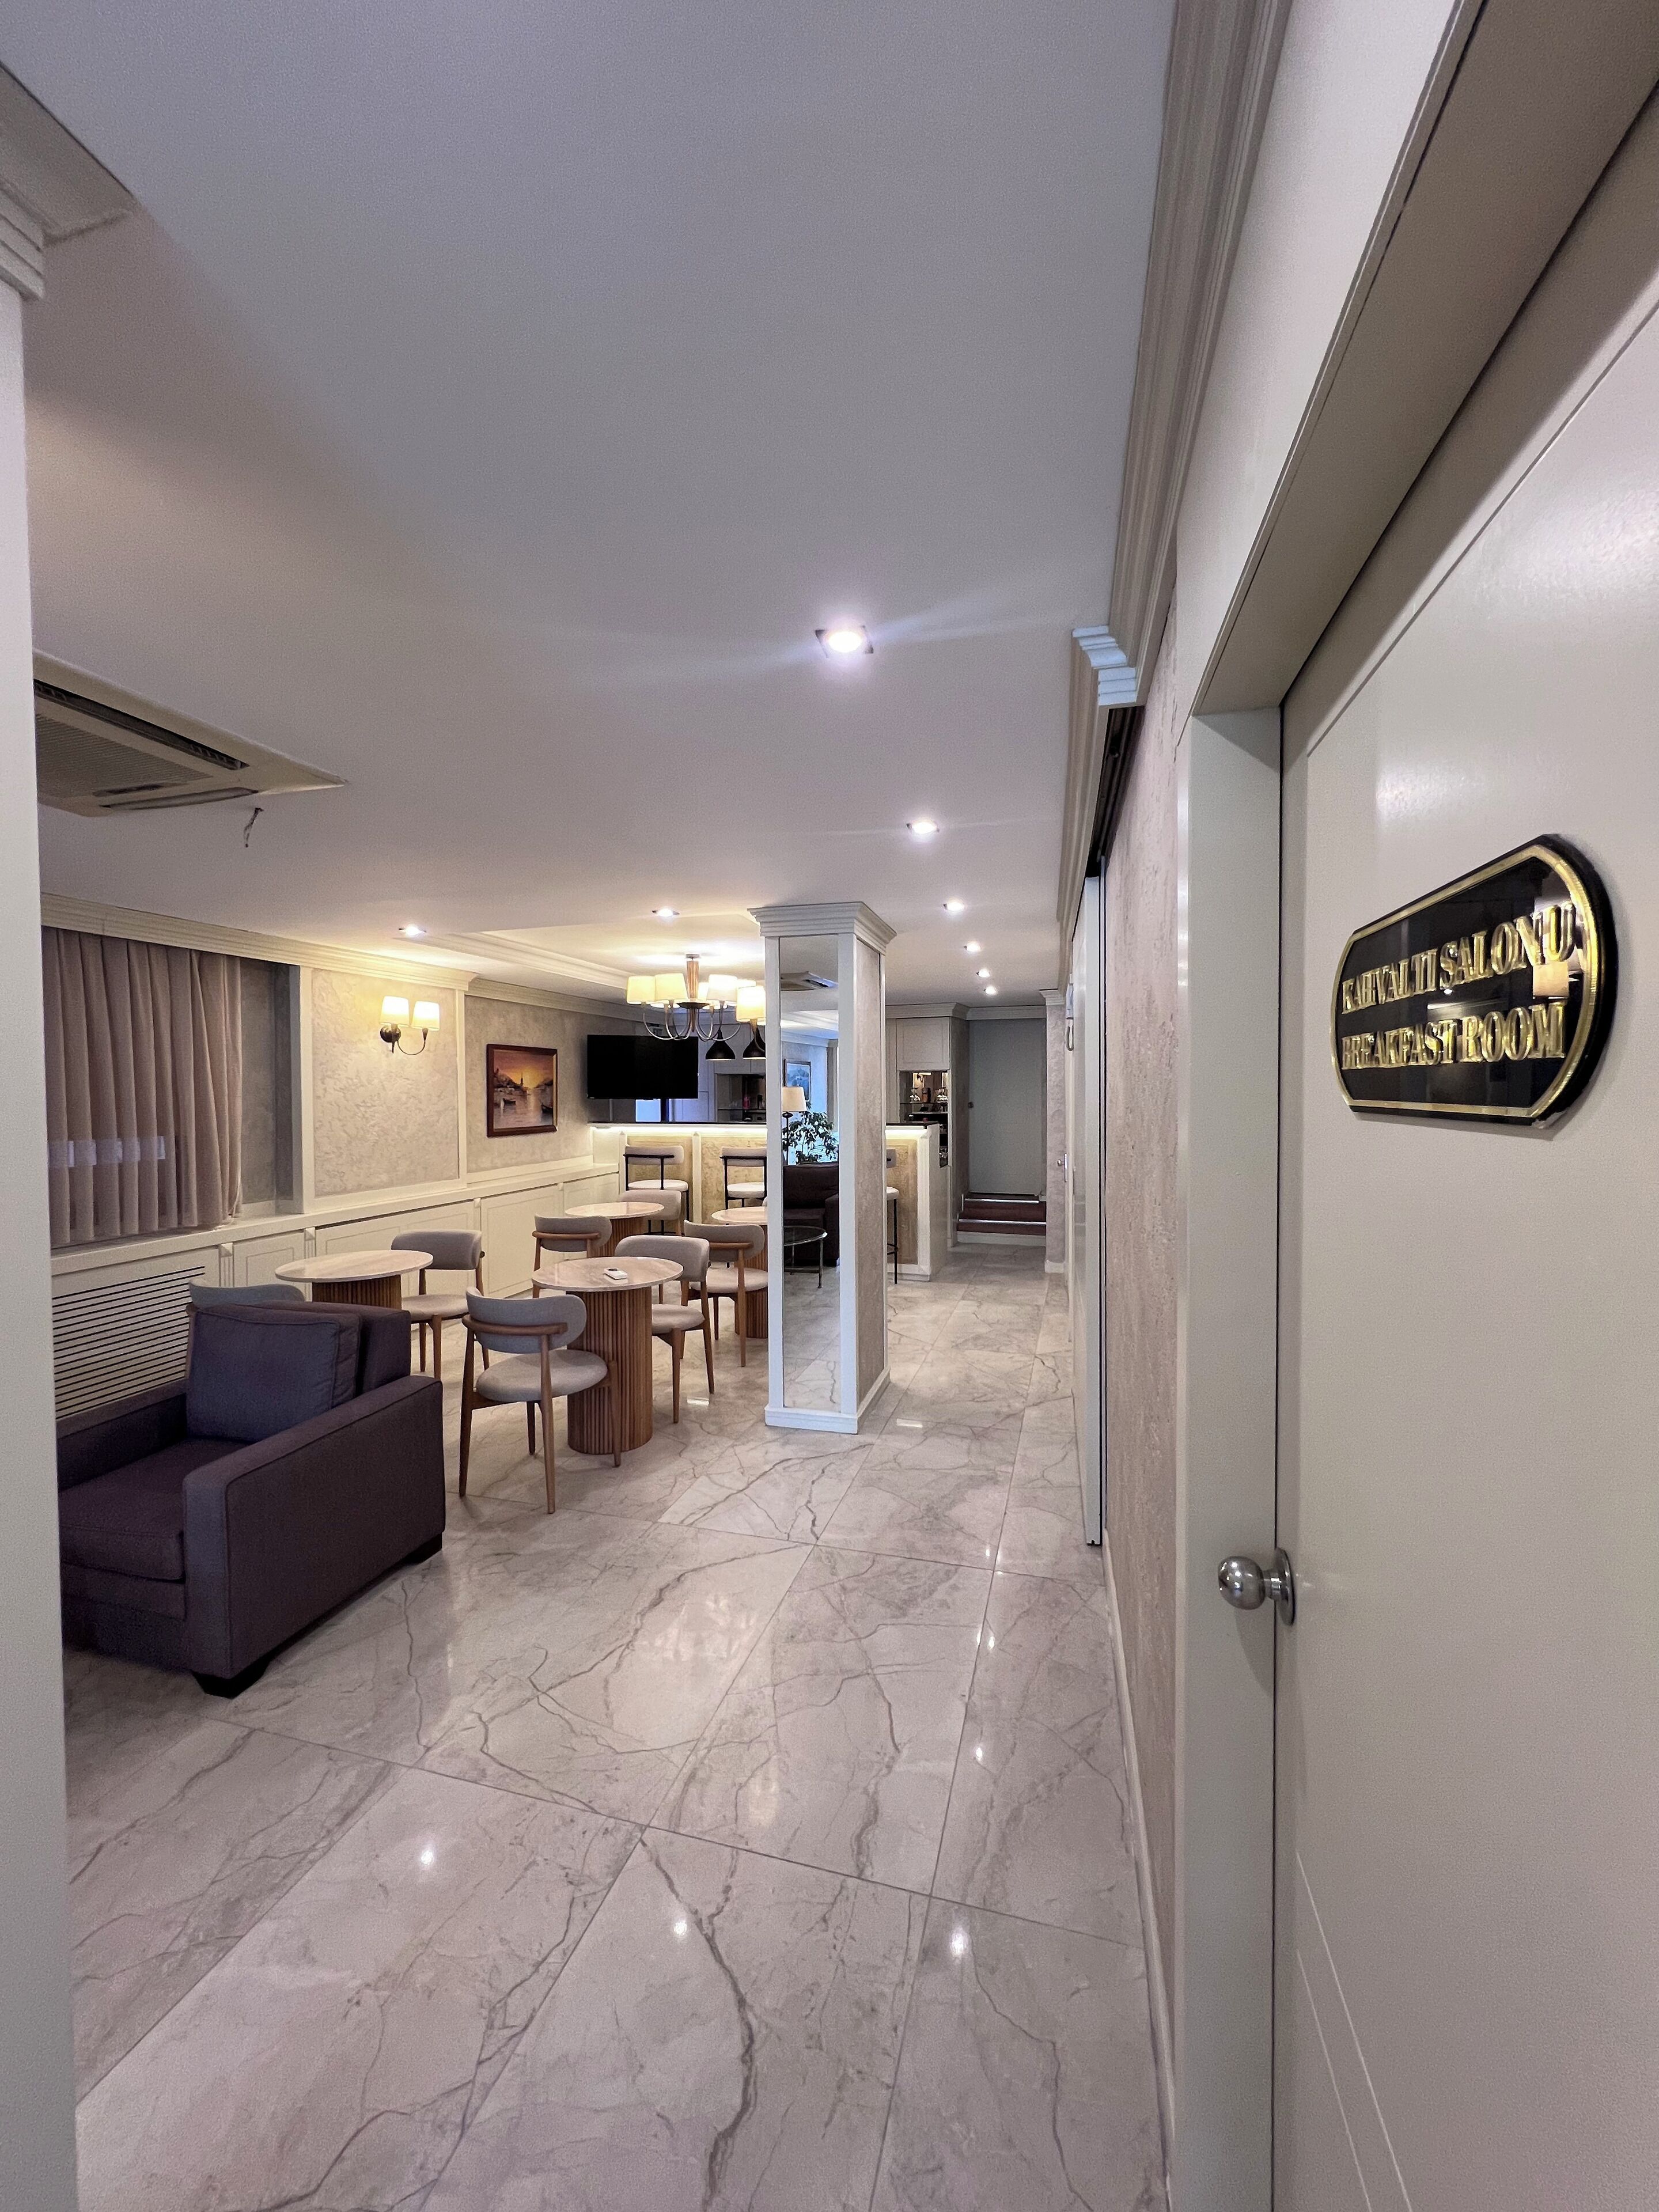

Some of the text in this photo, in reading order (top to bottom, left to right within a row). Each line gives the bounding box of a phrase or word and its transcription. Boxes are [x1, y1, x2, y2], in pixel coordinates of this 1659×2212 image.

[1342, 902, 1576, 1014] KAHVALTI SALONU
[1342, 1003, 1566, 1070] BREAKFAST ROOM
